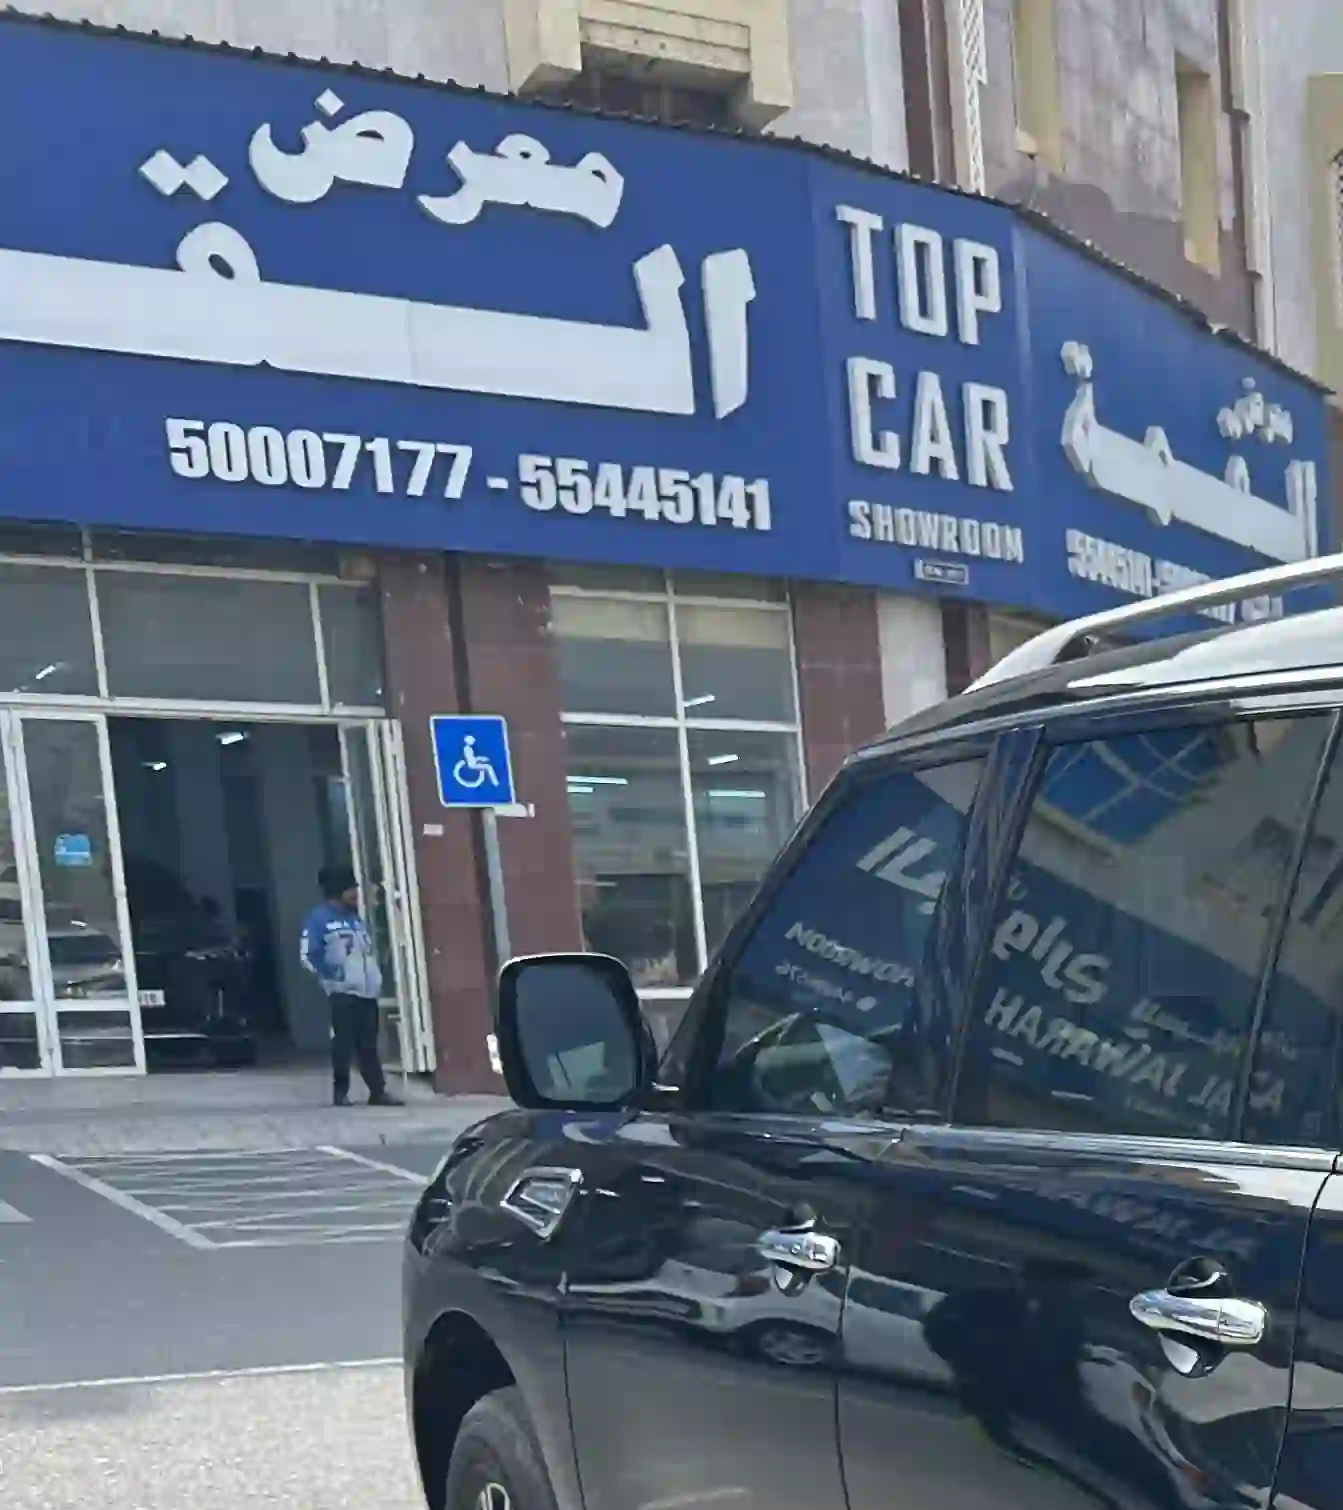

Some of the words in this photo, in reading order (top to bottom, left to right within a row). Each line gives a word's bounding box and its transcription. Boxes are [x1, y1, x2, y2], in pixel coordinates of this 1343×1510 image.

[249, 88, 625, 228] معرض
[836, 204, 1002, 345] TOP
[164, 417, 473, 500] 50007177
[518, 454, 773, 532] 55445141
[847, 356, 1014, 491] CAR
[848, 500, 1025, 564] SHOWROOM
